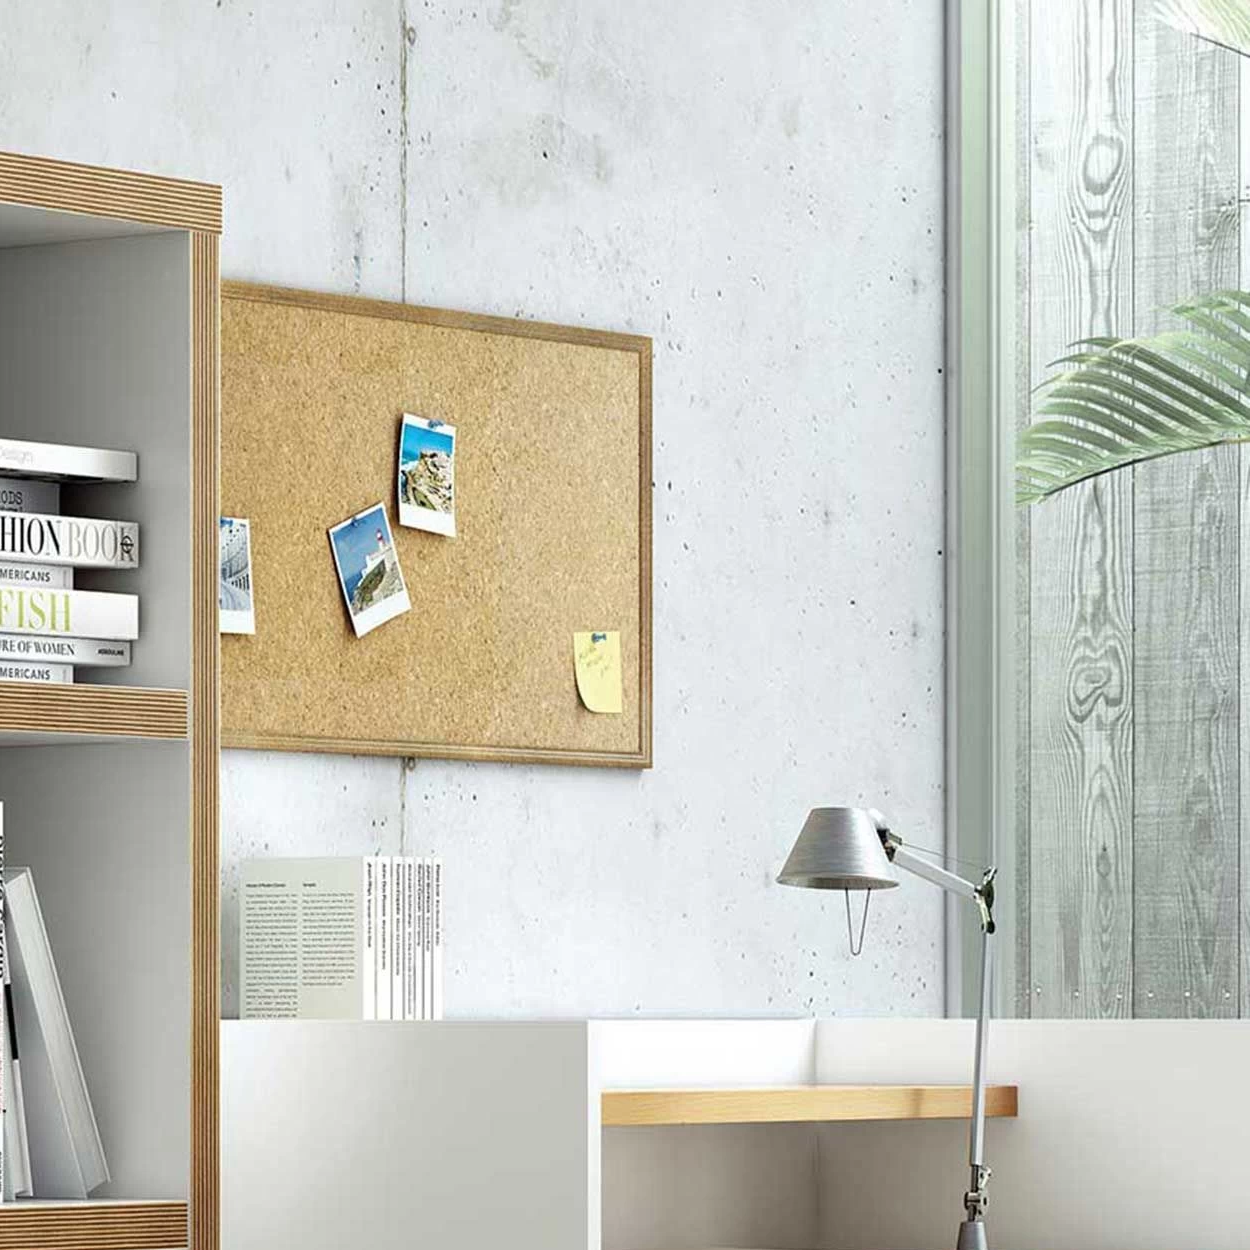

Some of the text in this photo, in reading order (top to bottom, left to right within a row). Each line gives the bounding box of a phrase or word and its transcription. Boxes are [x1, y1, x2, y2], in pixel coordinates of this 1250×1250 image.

[67, 521, 135, 562] BOOK
[16, 640, 32, 653] OF
[33, 641, 76, 656] WOMEN
